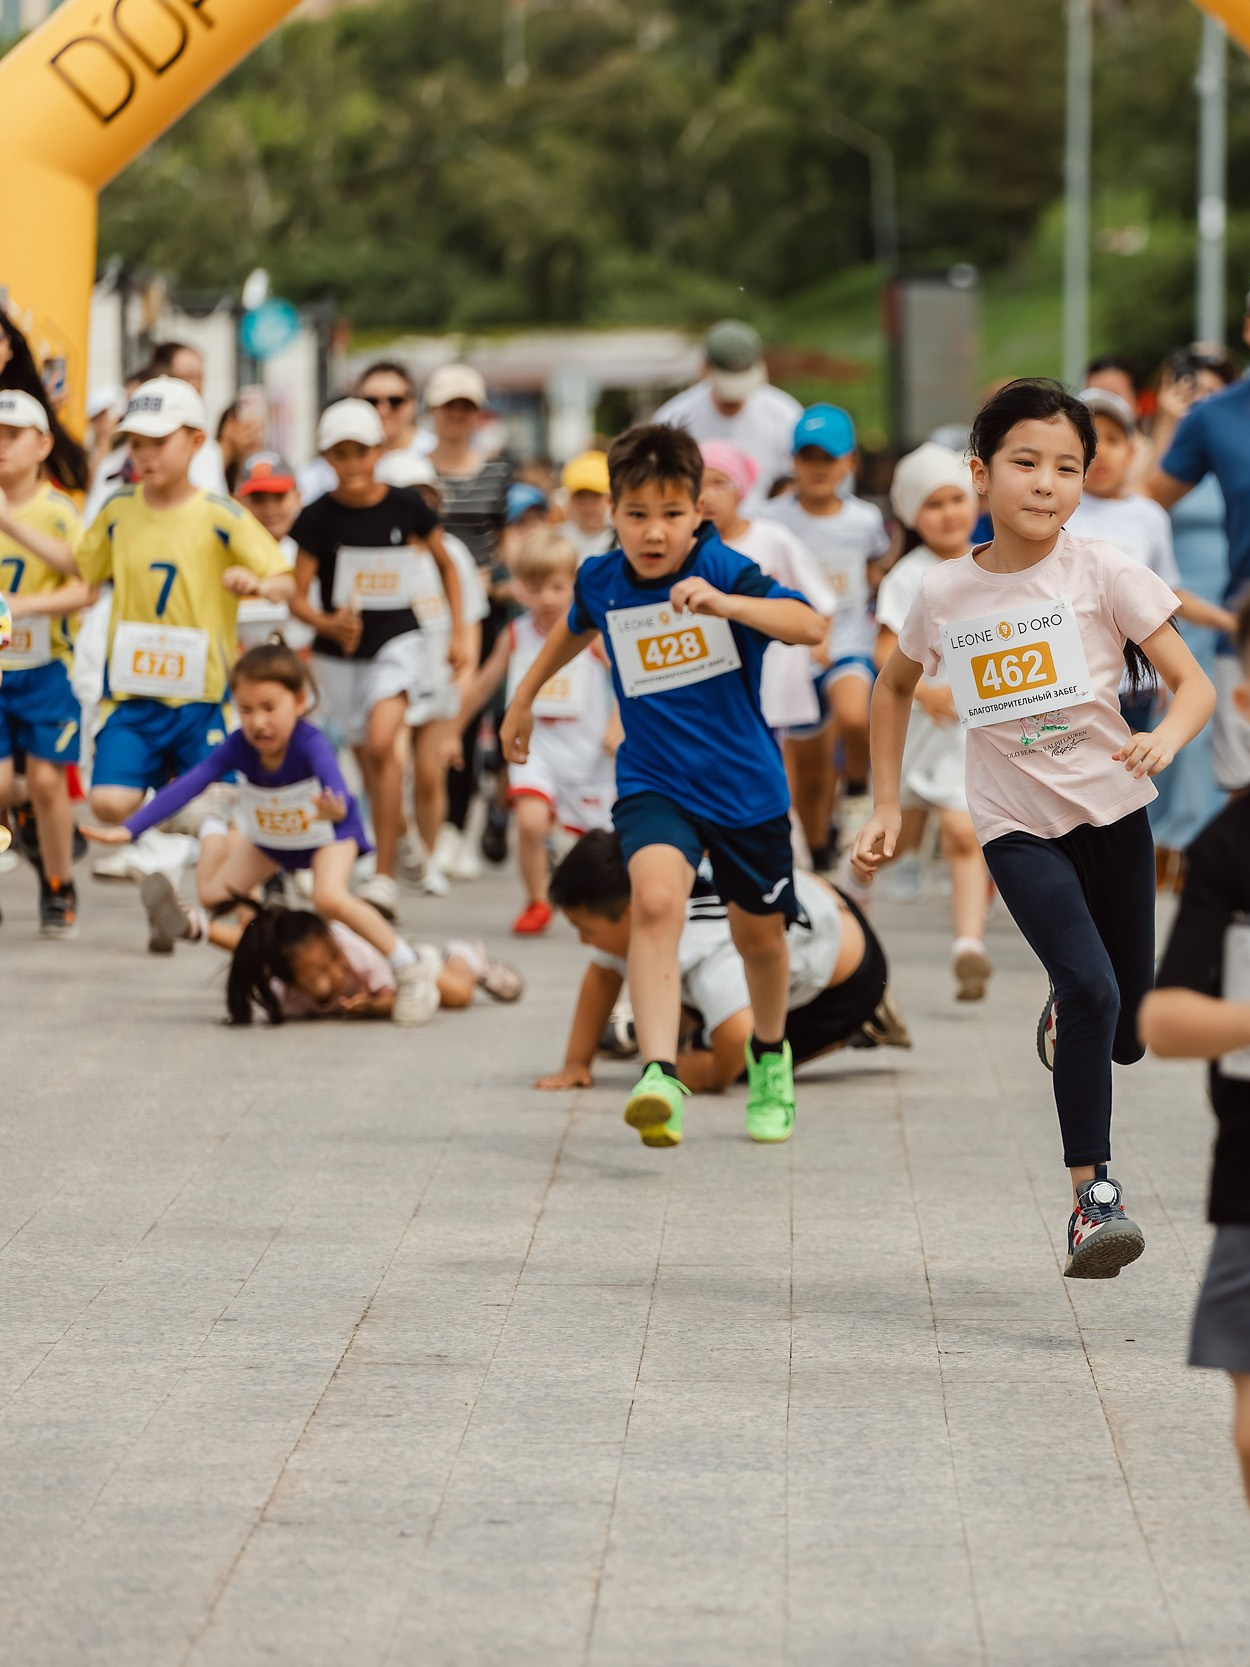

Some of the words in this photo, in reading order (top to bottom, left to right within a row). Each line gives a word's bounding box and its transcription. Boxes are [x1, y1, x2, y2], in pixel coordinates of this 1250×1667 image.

[48, 0, 214, 126] D'O
[149, 563, 178, 617] 7
[645, 631, 702, 667] 428
[950, 629, 994, 650] LEONE
[1017, 613, 1063, 635] D'ORO
[981, 649, 1048, 691] 462
[967, 691, 1053, 717] БЛАГОТВОРИТЕЛЬНЫЙ
[1053, 685, 1078, 698] ЗАБЕГ
[1042, 739, 1063, 752] RALPH
[1062, 730, 1087, 744] LAUREN
